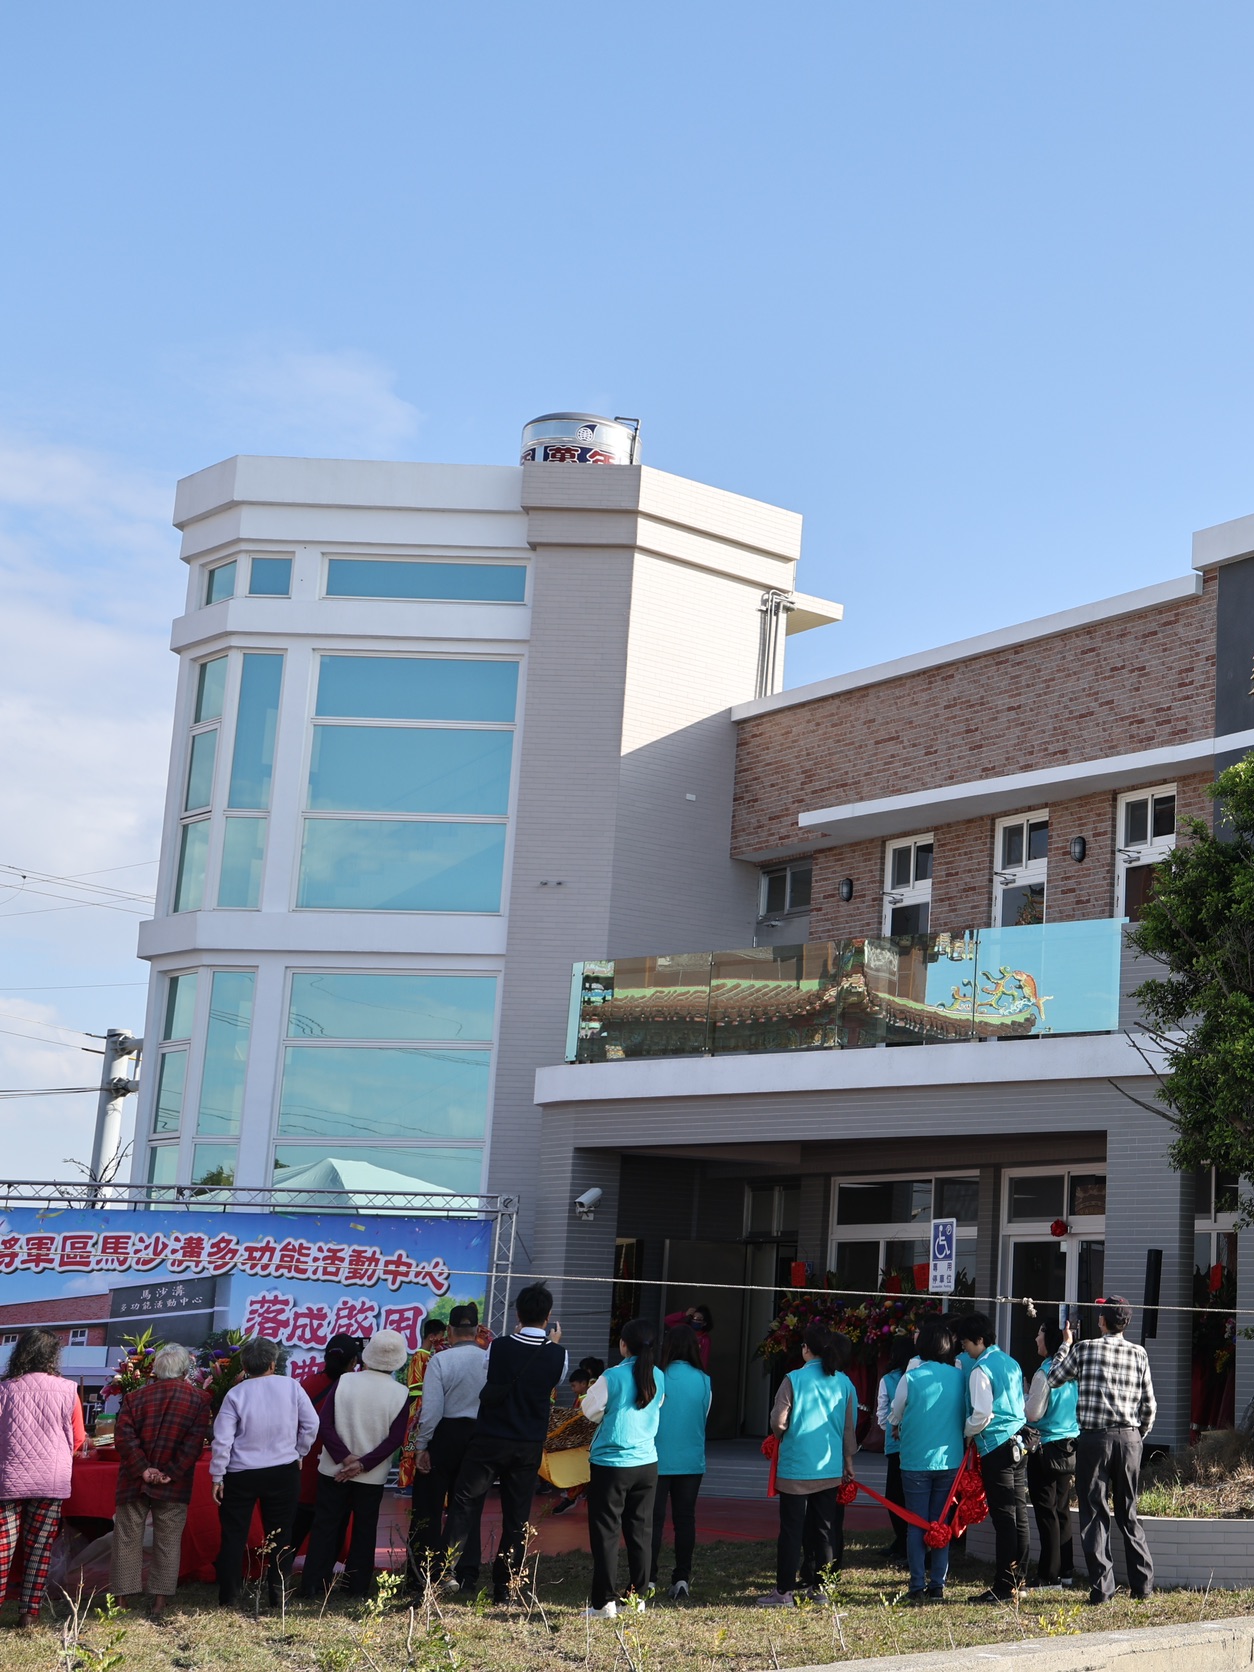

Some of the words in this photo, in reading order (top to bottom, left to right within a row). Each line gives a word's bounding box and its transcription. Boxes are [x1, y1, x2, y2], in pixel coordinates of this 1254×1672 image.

[0, 1233, 447, 1293] 將軍區馬沙溝多功能活動中心
[140, 1284, 186, 1301] 馬沙溝
[120, 1296, 203, 1313] 多功能活動中心
